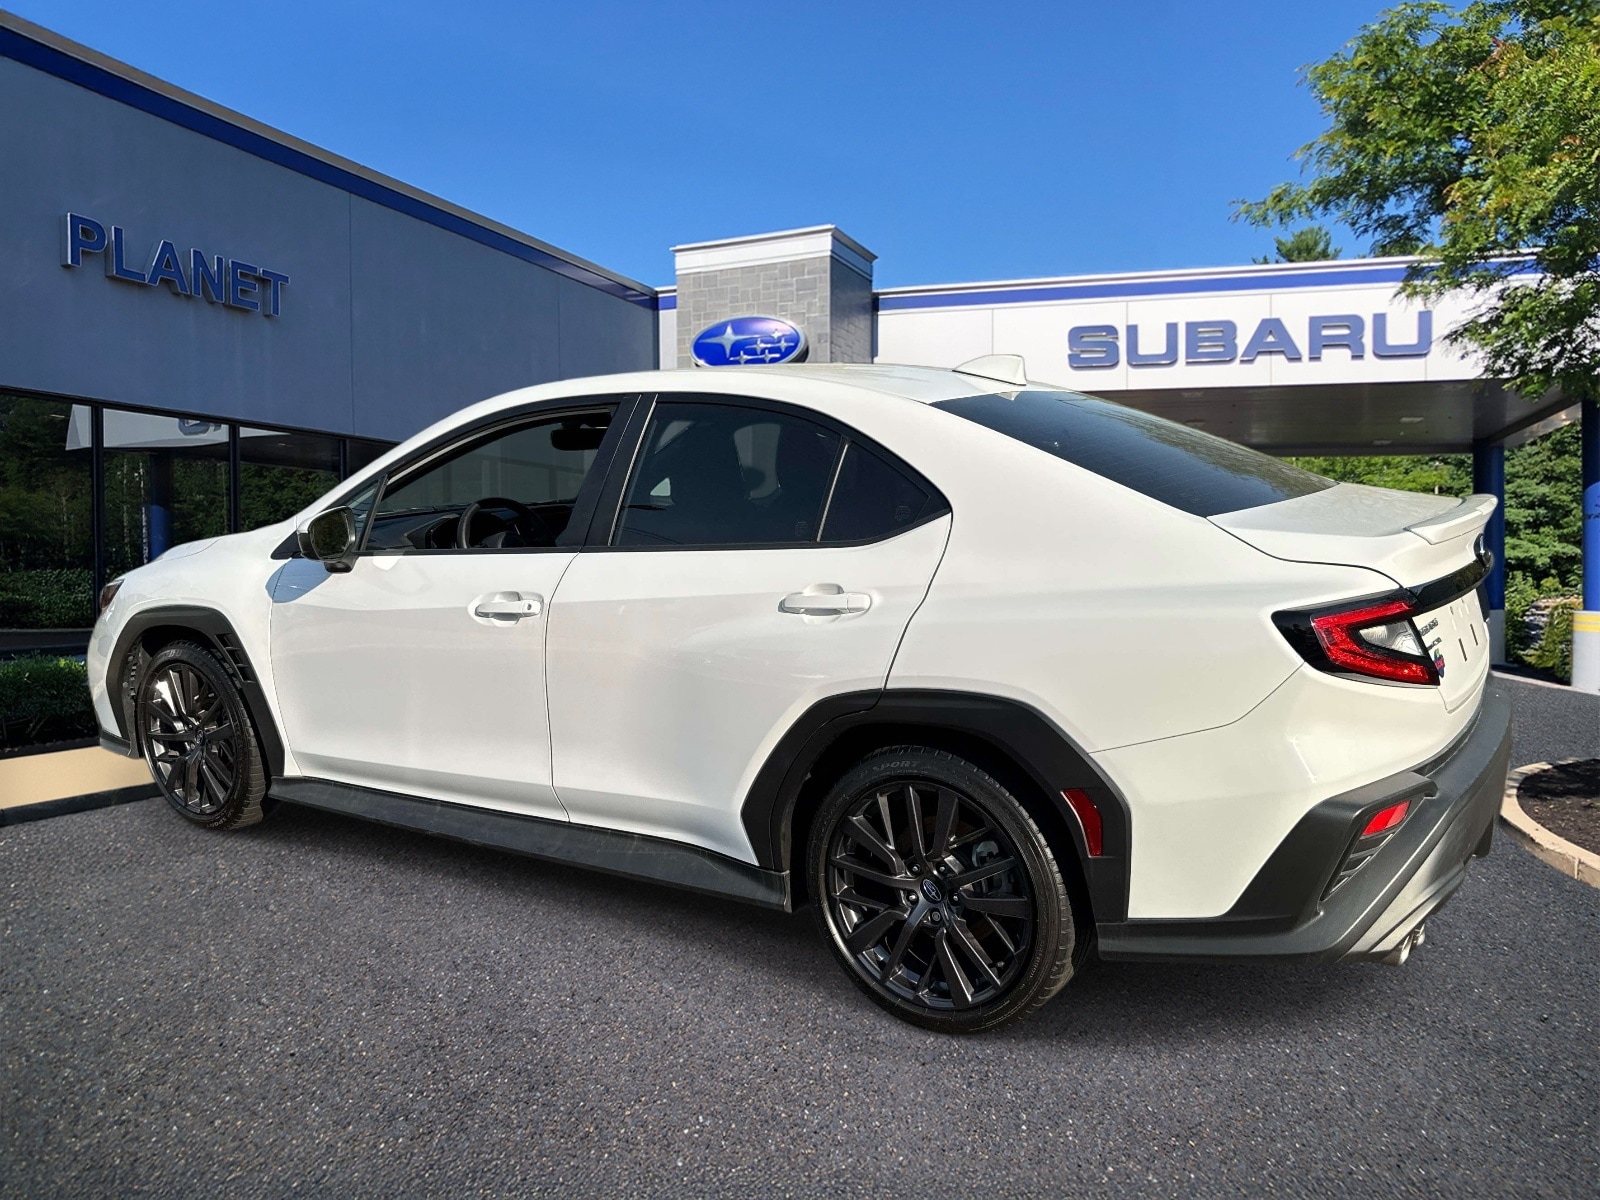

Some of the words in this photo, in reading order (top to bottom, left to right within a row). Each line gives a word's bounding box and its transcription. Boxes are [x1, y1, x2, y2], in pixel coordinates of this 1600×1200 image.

[66, 212, 290, 317] PLANET
[1067, 310, 1433, 370] SUBARU
[872, 760, 919, 771] SPORT
